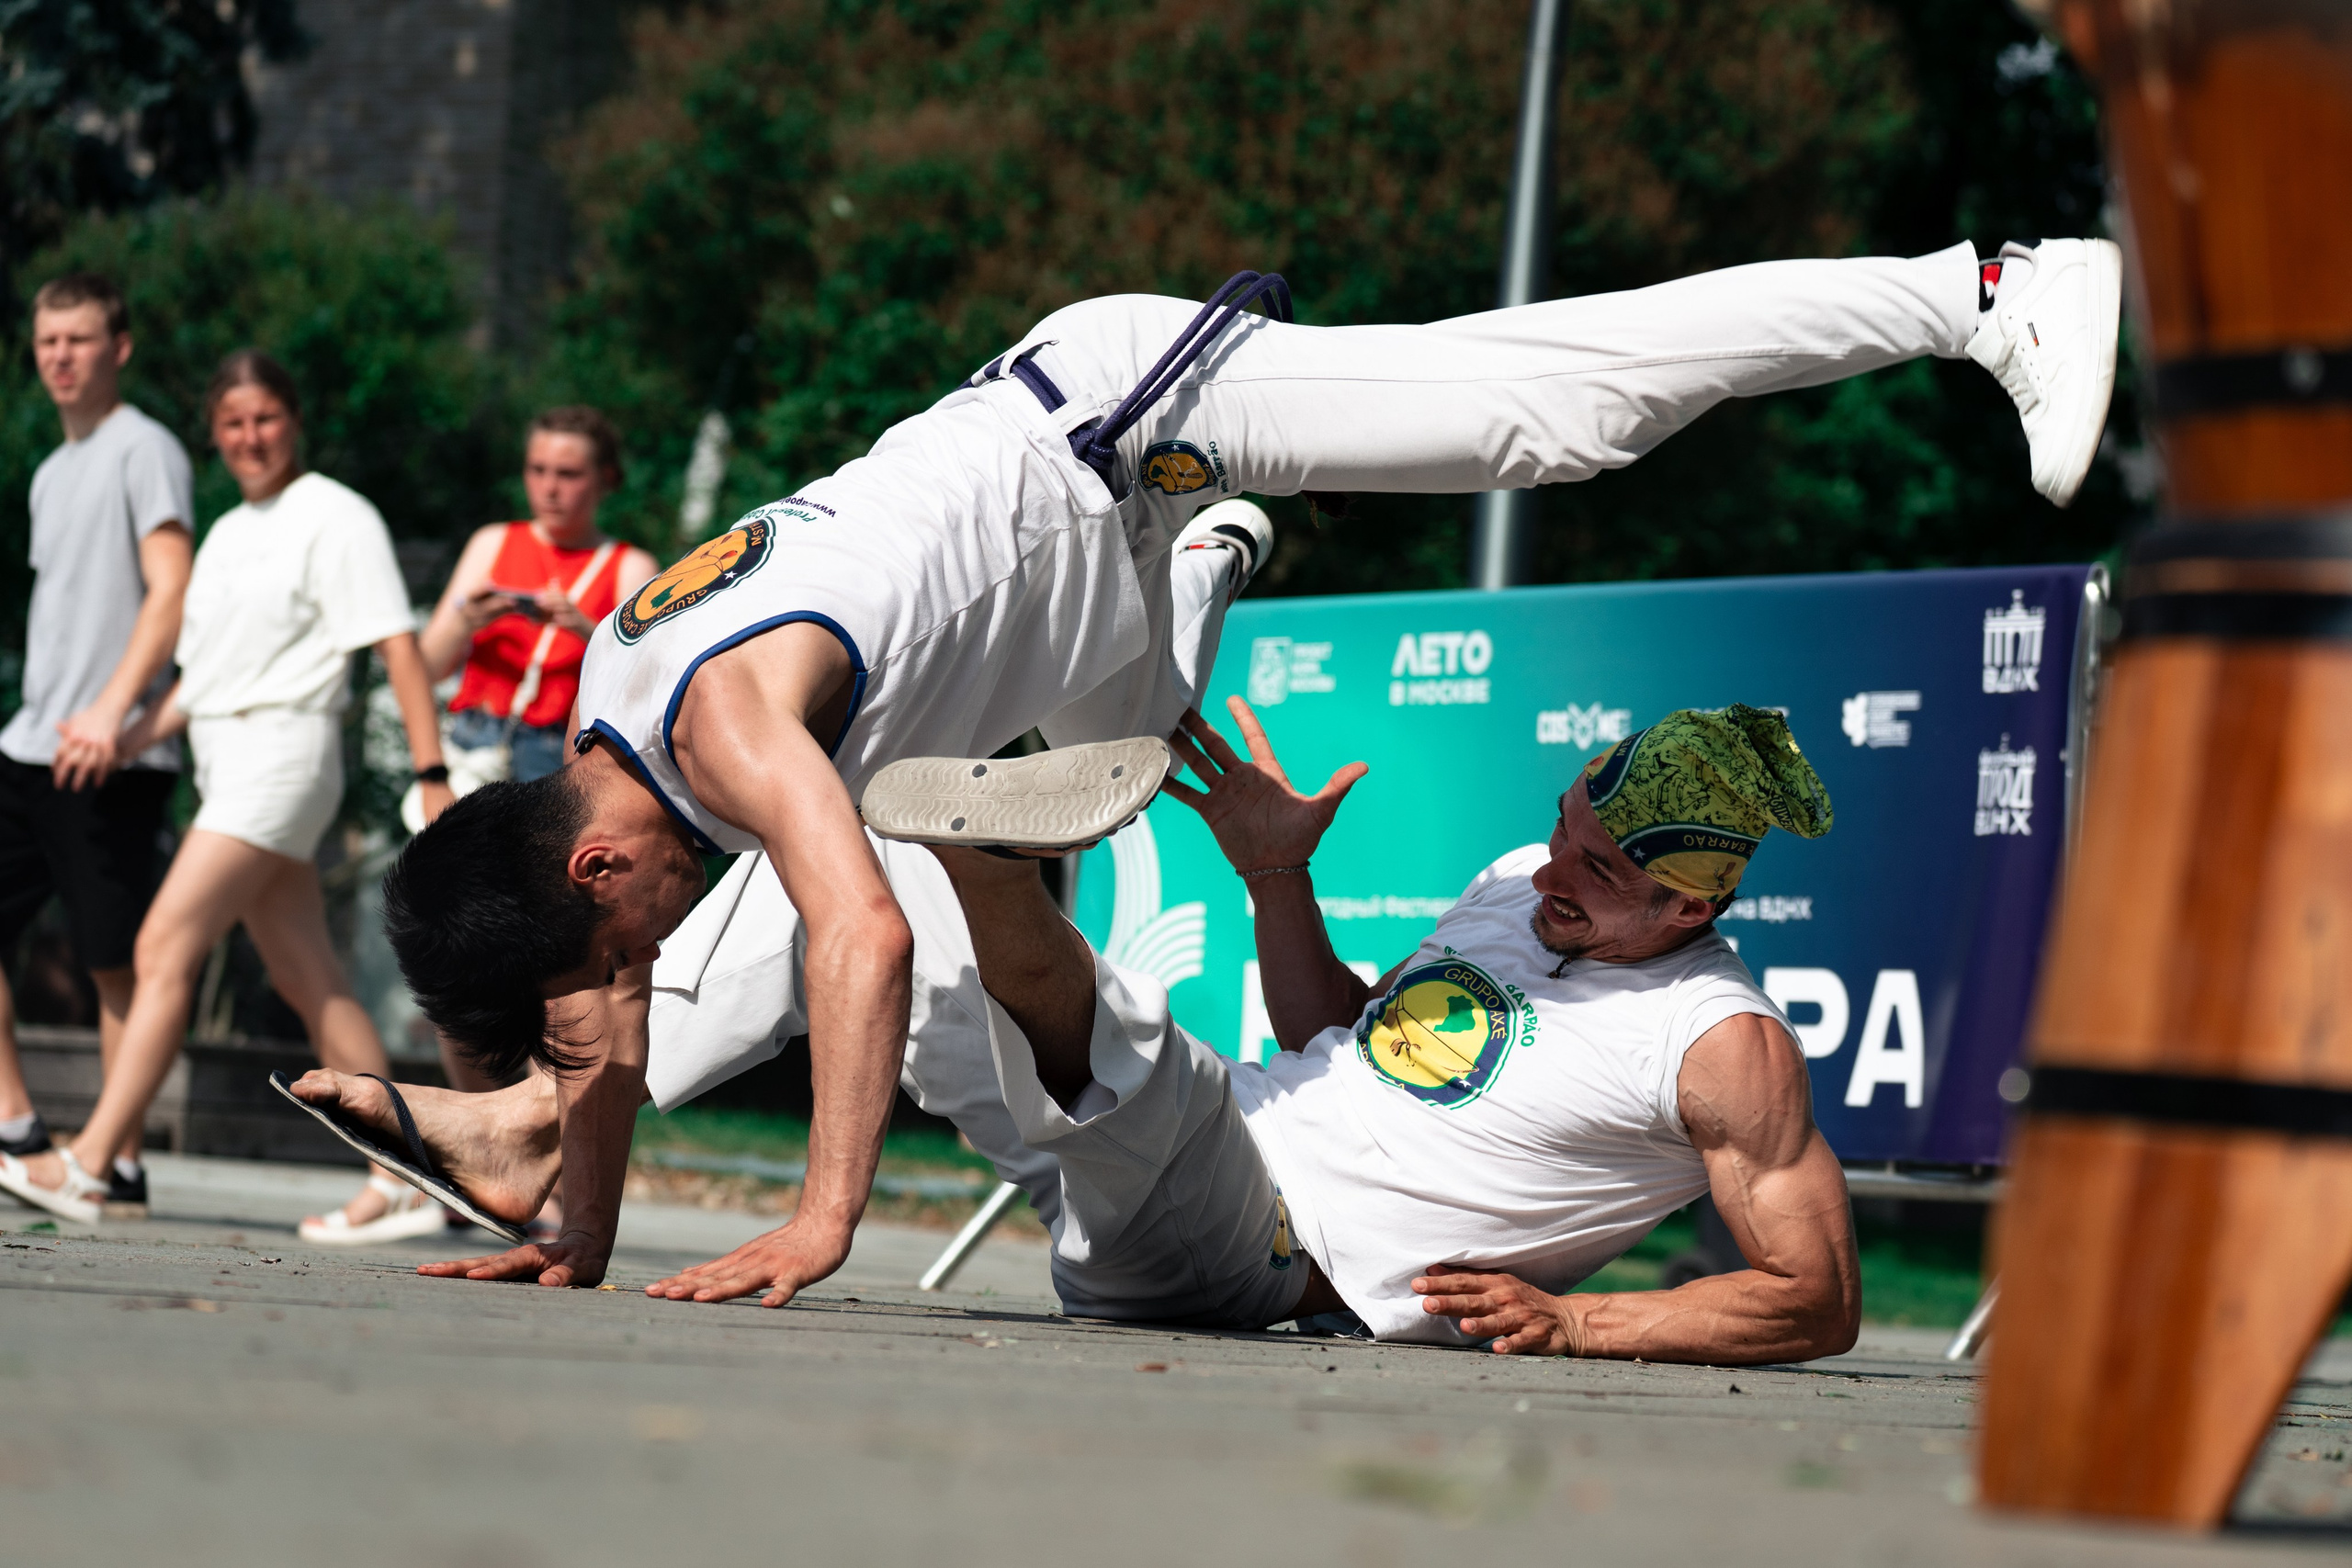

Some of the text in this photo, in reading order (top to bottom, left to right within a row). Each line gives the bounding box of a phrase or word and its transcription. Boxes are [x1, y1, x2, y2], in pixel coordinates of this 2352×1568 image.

[1207, 441, 1227, 477] Barrão
[656, 589, 707, 619] GRUPO
[1391, 629, 1494, 678] ЛЕТО
[1388, 678, 1491, 706] В МОСКВЕ
[1683, 833, 1747, 852] BARRÃO
[1759, 895, 1813, 924] ВДНХ
[1444, 967, 1500, 1009] GRUPO
[1490, 1010, 1508, 1040] AXÉ
